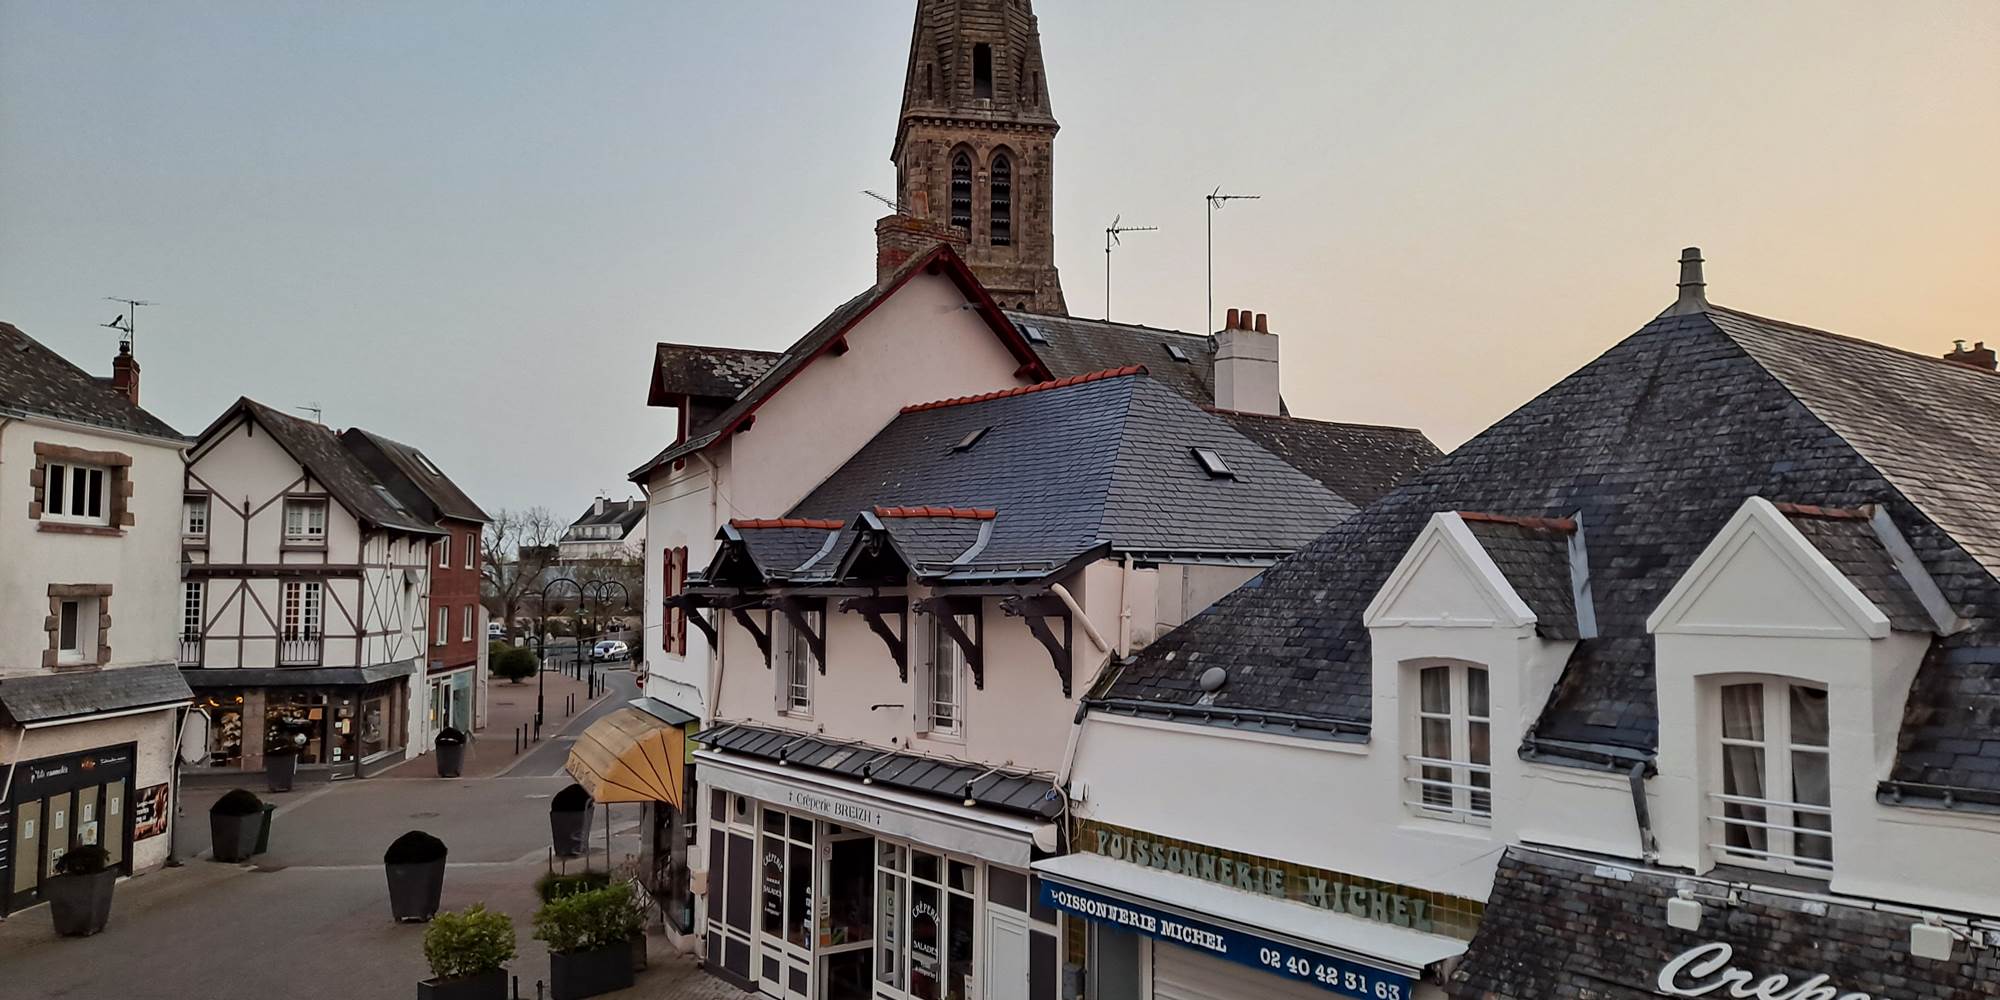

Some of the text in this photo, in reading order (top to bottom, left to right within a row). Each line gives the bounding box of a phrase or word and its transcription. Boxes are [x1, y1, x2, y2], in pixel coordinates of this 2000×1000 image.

[796, 792, 872, 823] Crêperie BREIZH
[1095, 830, 1433, 933] POISSONNERIE MICHEL
[1160, 919, 1228, 953] MICHEL
[1259, 947, 1282, 969] 02
[1286, 956, 1311, 976] 40
[1315, 964, 1339, 985] 42
[1344, 971, 1368, 994] 31
[1374, 981, 1400, 1000] 63
[1657, 942, 1890, 1000] Crep
